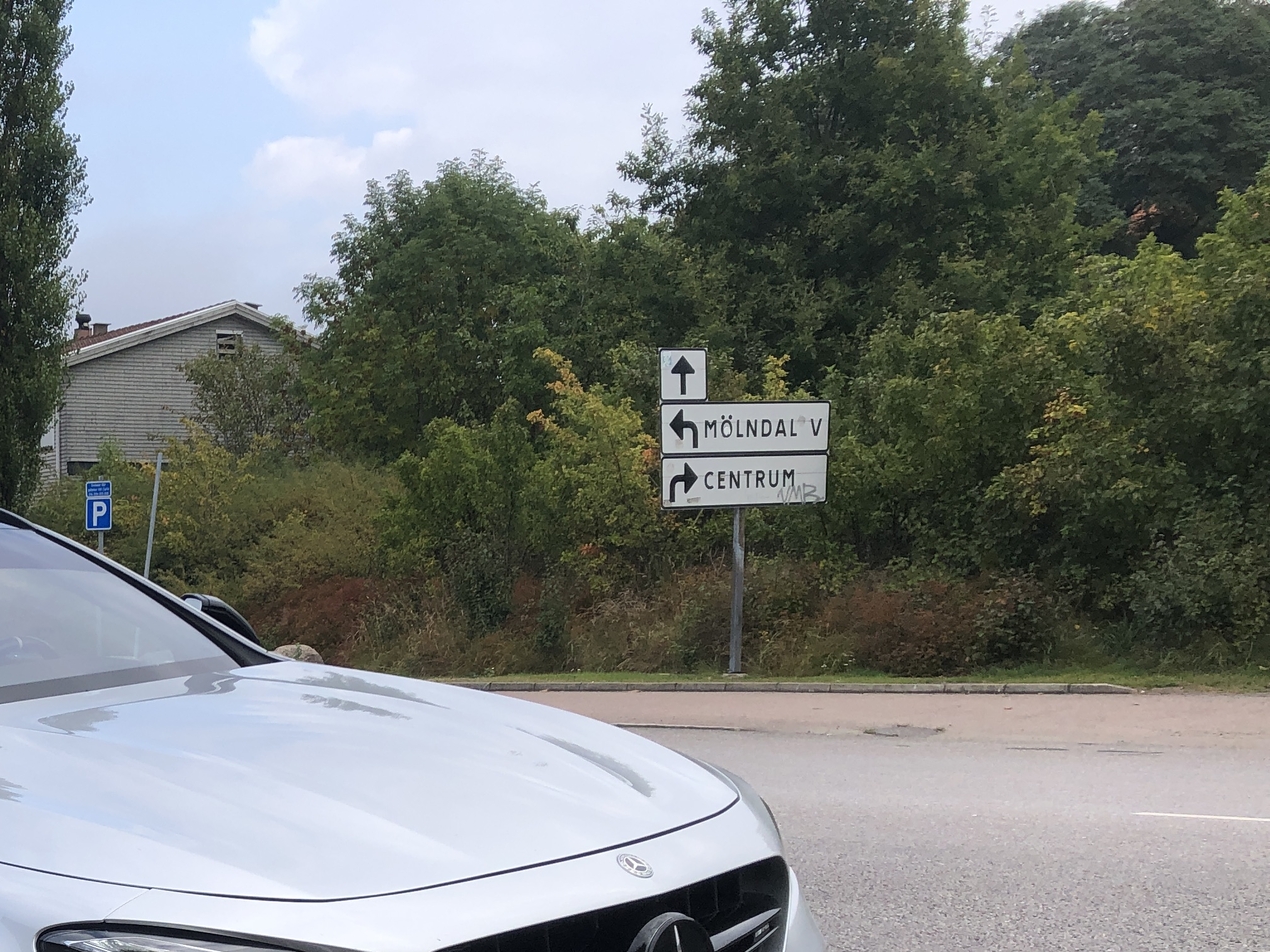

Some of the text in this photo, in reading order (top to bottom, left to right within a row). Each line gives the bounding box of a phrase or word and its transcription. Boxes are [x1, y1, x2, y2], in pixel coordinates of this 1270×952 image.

[704, 414, 823, 438] MÖLNDAL V
[704, 468, 795, 490] CENTRUM
[92, 501, 107, 527] P
